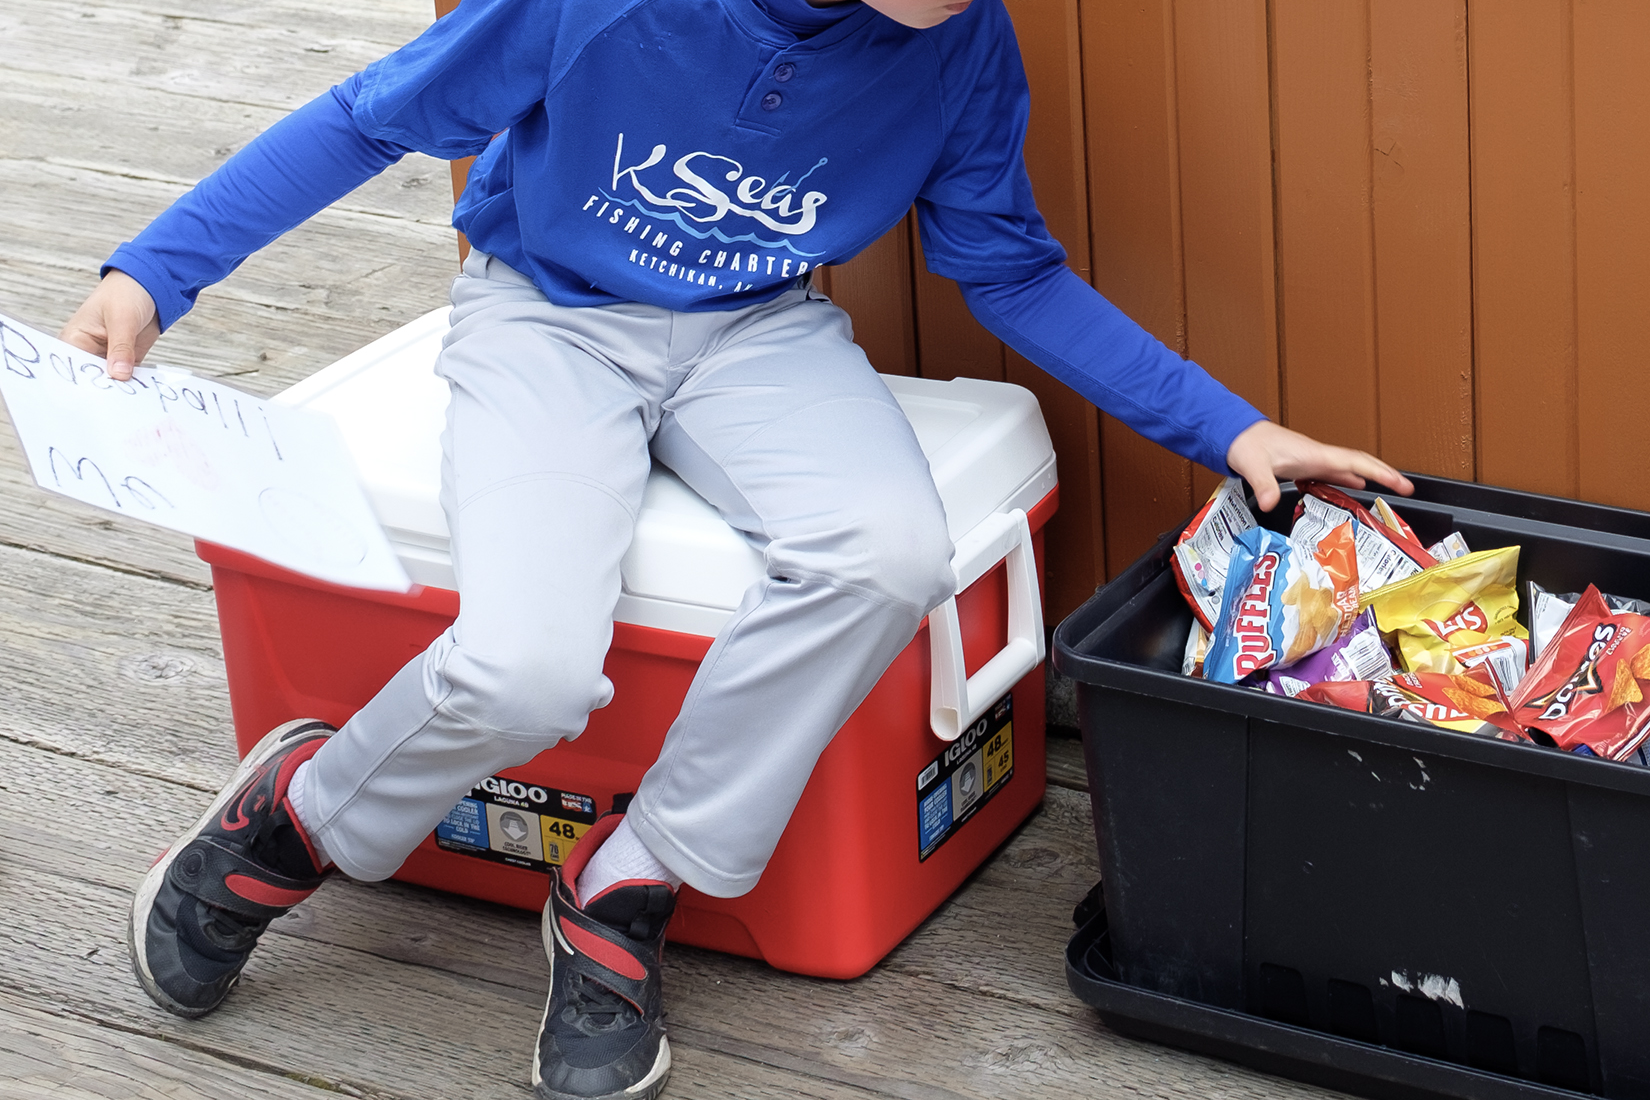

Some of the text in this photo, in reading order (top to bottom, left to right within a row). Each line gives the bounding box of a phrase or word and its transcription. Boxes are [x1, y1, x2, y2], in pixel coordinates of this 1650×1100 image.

[582, 194, 684, 258] FISHING
[629, 248, 724, 290] KETCHIKAN,
[1232, 551, 1280, 681] RUFFLES
[944, 718, 988, 768] IGLOO
[987, 734, 1002, 759] 48
[998, 750, 1010, 769] 45
[548, 821, 576, 840] 48
